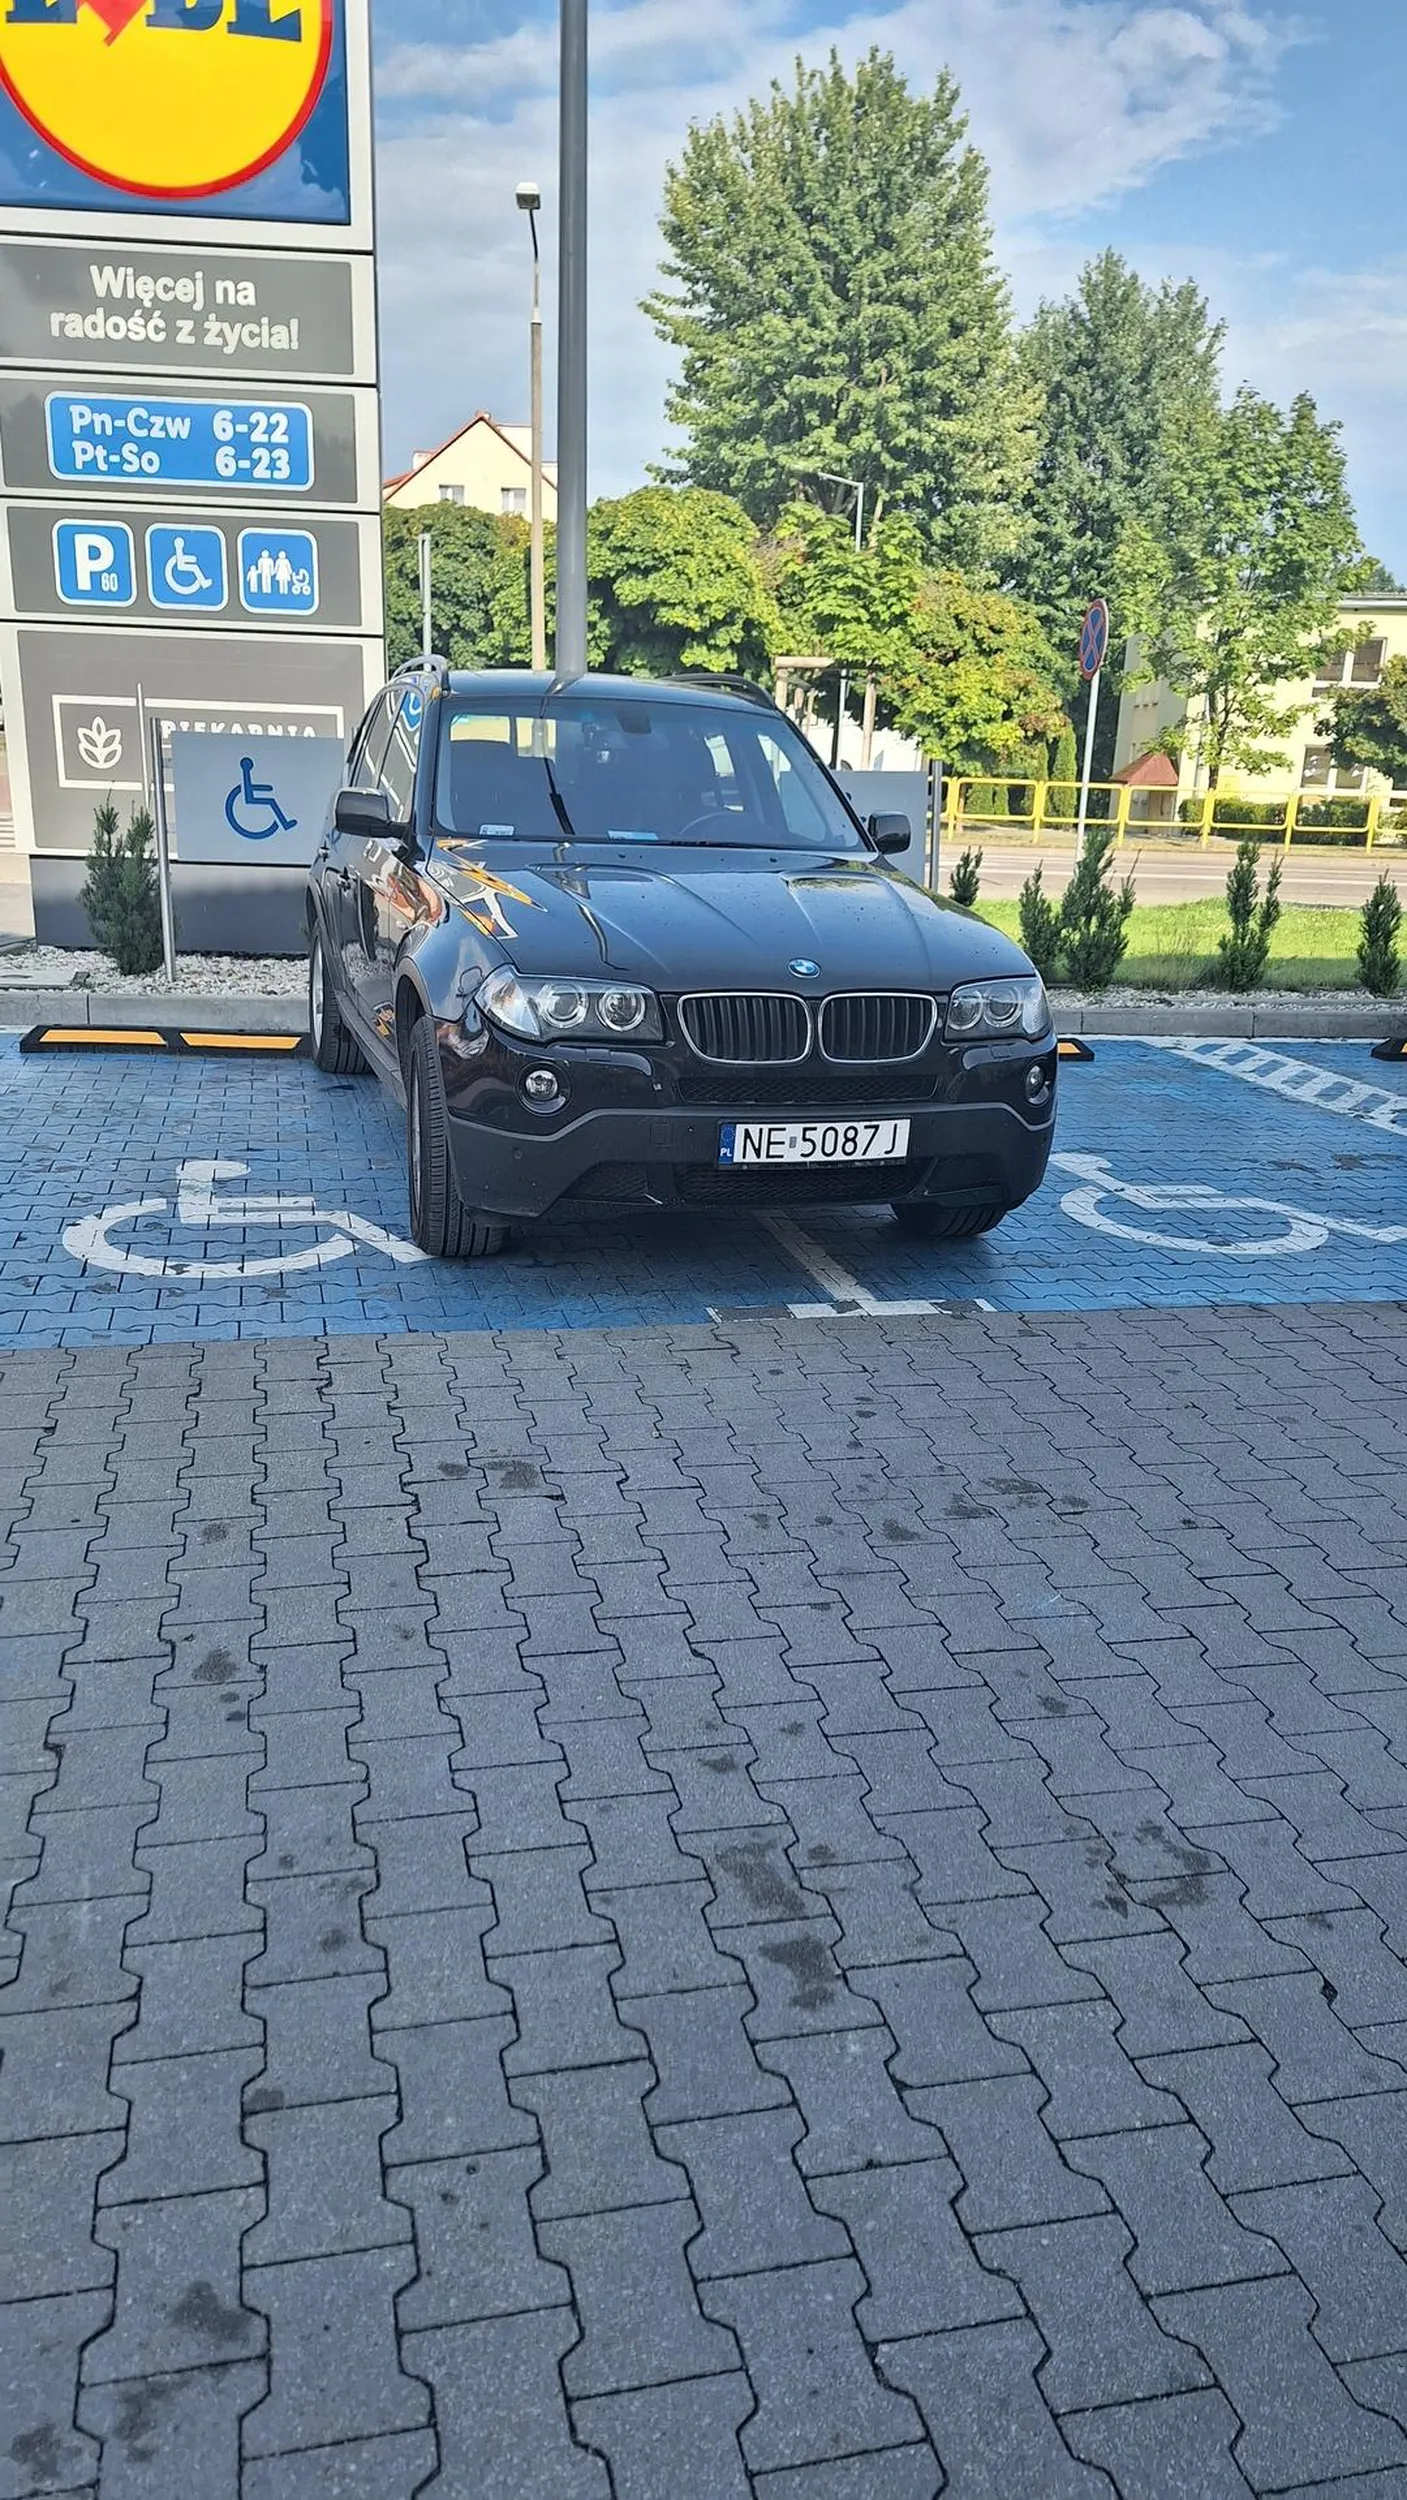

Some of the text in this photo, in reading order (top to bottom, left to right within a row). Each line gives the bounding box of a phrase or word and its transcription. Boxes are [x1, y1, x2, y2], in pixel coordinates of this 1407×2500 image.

[89, 264, 257, 312] Więcej na
[49, 306, 300, 355] radość z życia!
[69, 404, 290, 444] Pn-Czw 6-22
[71, 441, 291, 480] Pt-So 6-23
[73, 533, 115, 591] P
[719, 1147, 733, 1158] PL
[741, 1122, 899, 1160] NE 5087J
